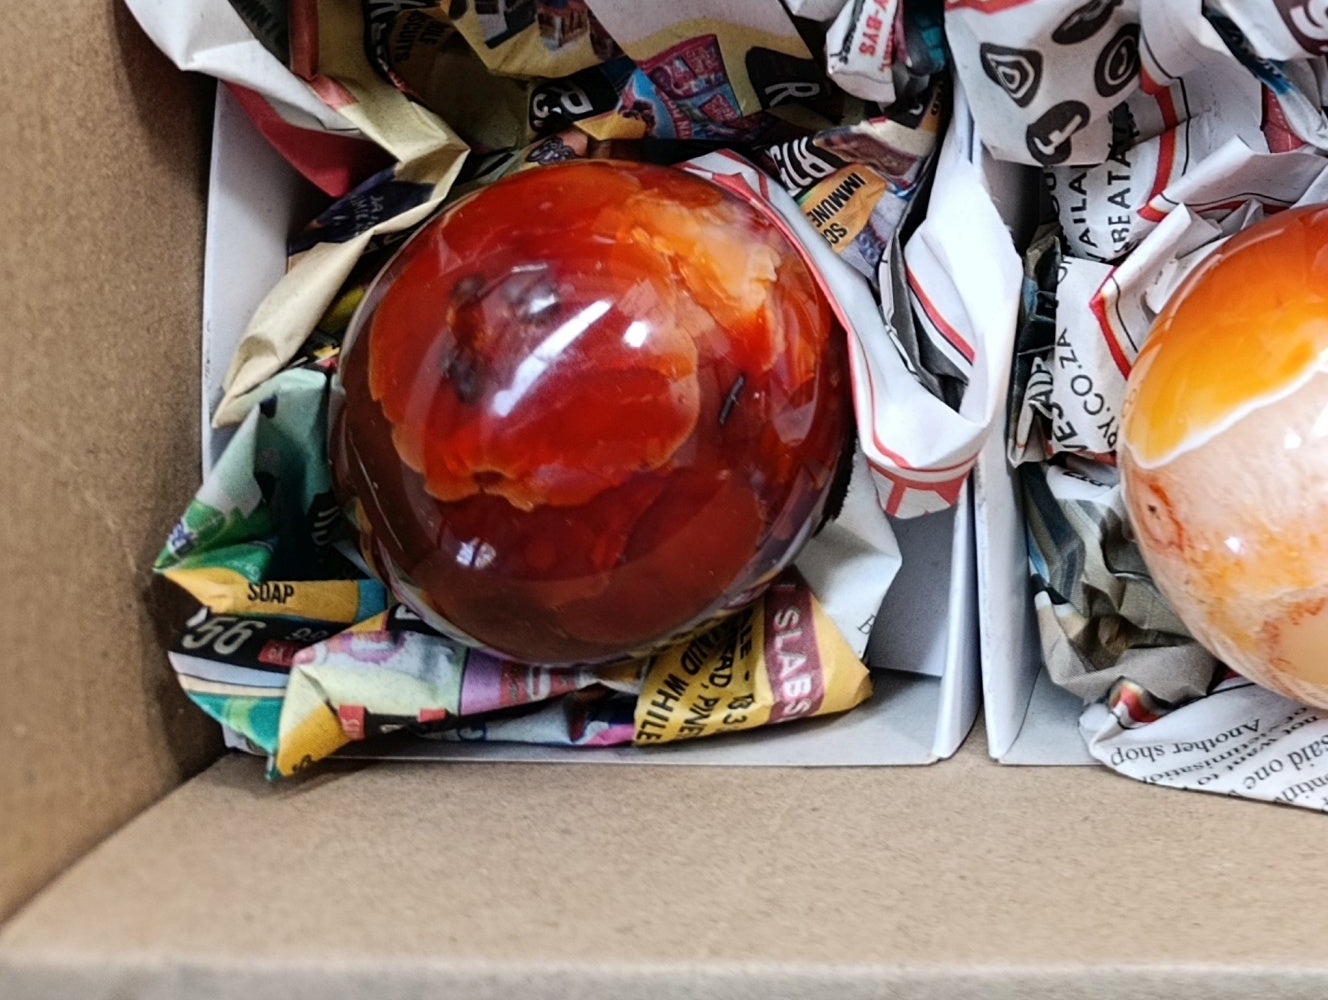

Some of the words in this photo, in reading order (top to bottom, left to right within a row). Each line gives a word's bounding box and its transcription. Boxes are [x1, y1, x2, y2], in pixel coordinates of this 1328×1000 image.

[806, 172, 866, 229] IMMUNE
[247, 581, 296, 605] SOAP
[773, 606, 813, 722] SLABS
[1173, 717, 1260, 757] Another
[1111, 743, 1166, 768] shop
[1242, 759, 1285, 790] one
